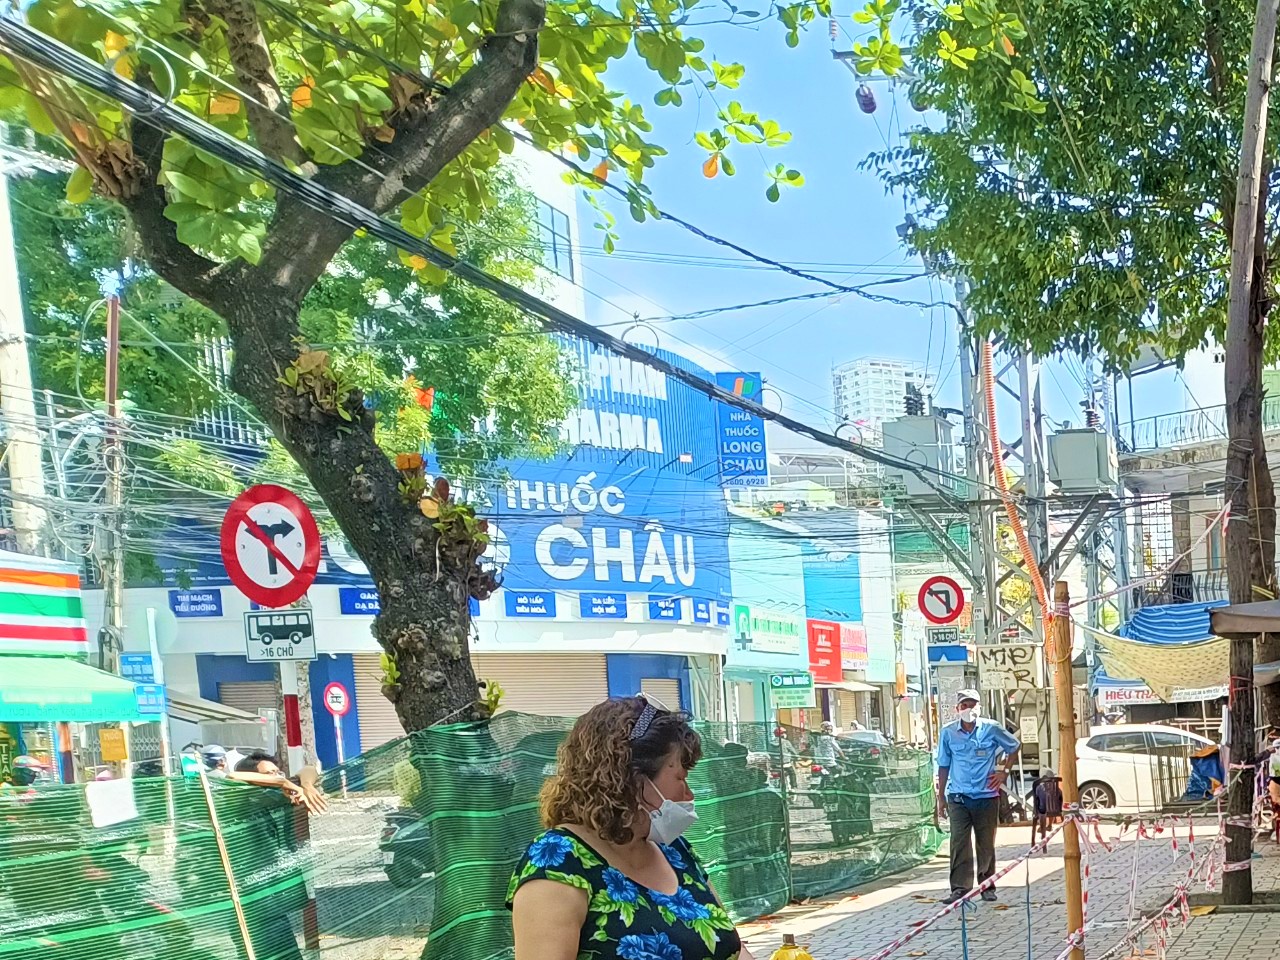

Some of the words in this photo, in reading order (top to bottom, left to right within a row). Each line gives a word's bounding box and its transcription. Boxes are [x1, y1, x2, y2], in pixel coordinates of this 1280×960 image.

[724, 425, 760, 437] THUỐC
[723, 441, 763, 453] LONG
[723, 456, 765, 471] CHÂU
[507, 471, 625, 514] THUỐC
[535, 519, 695, 586] CHÂU
[277, 643, 294, 657] CHỖ
